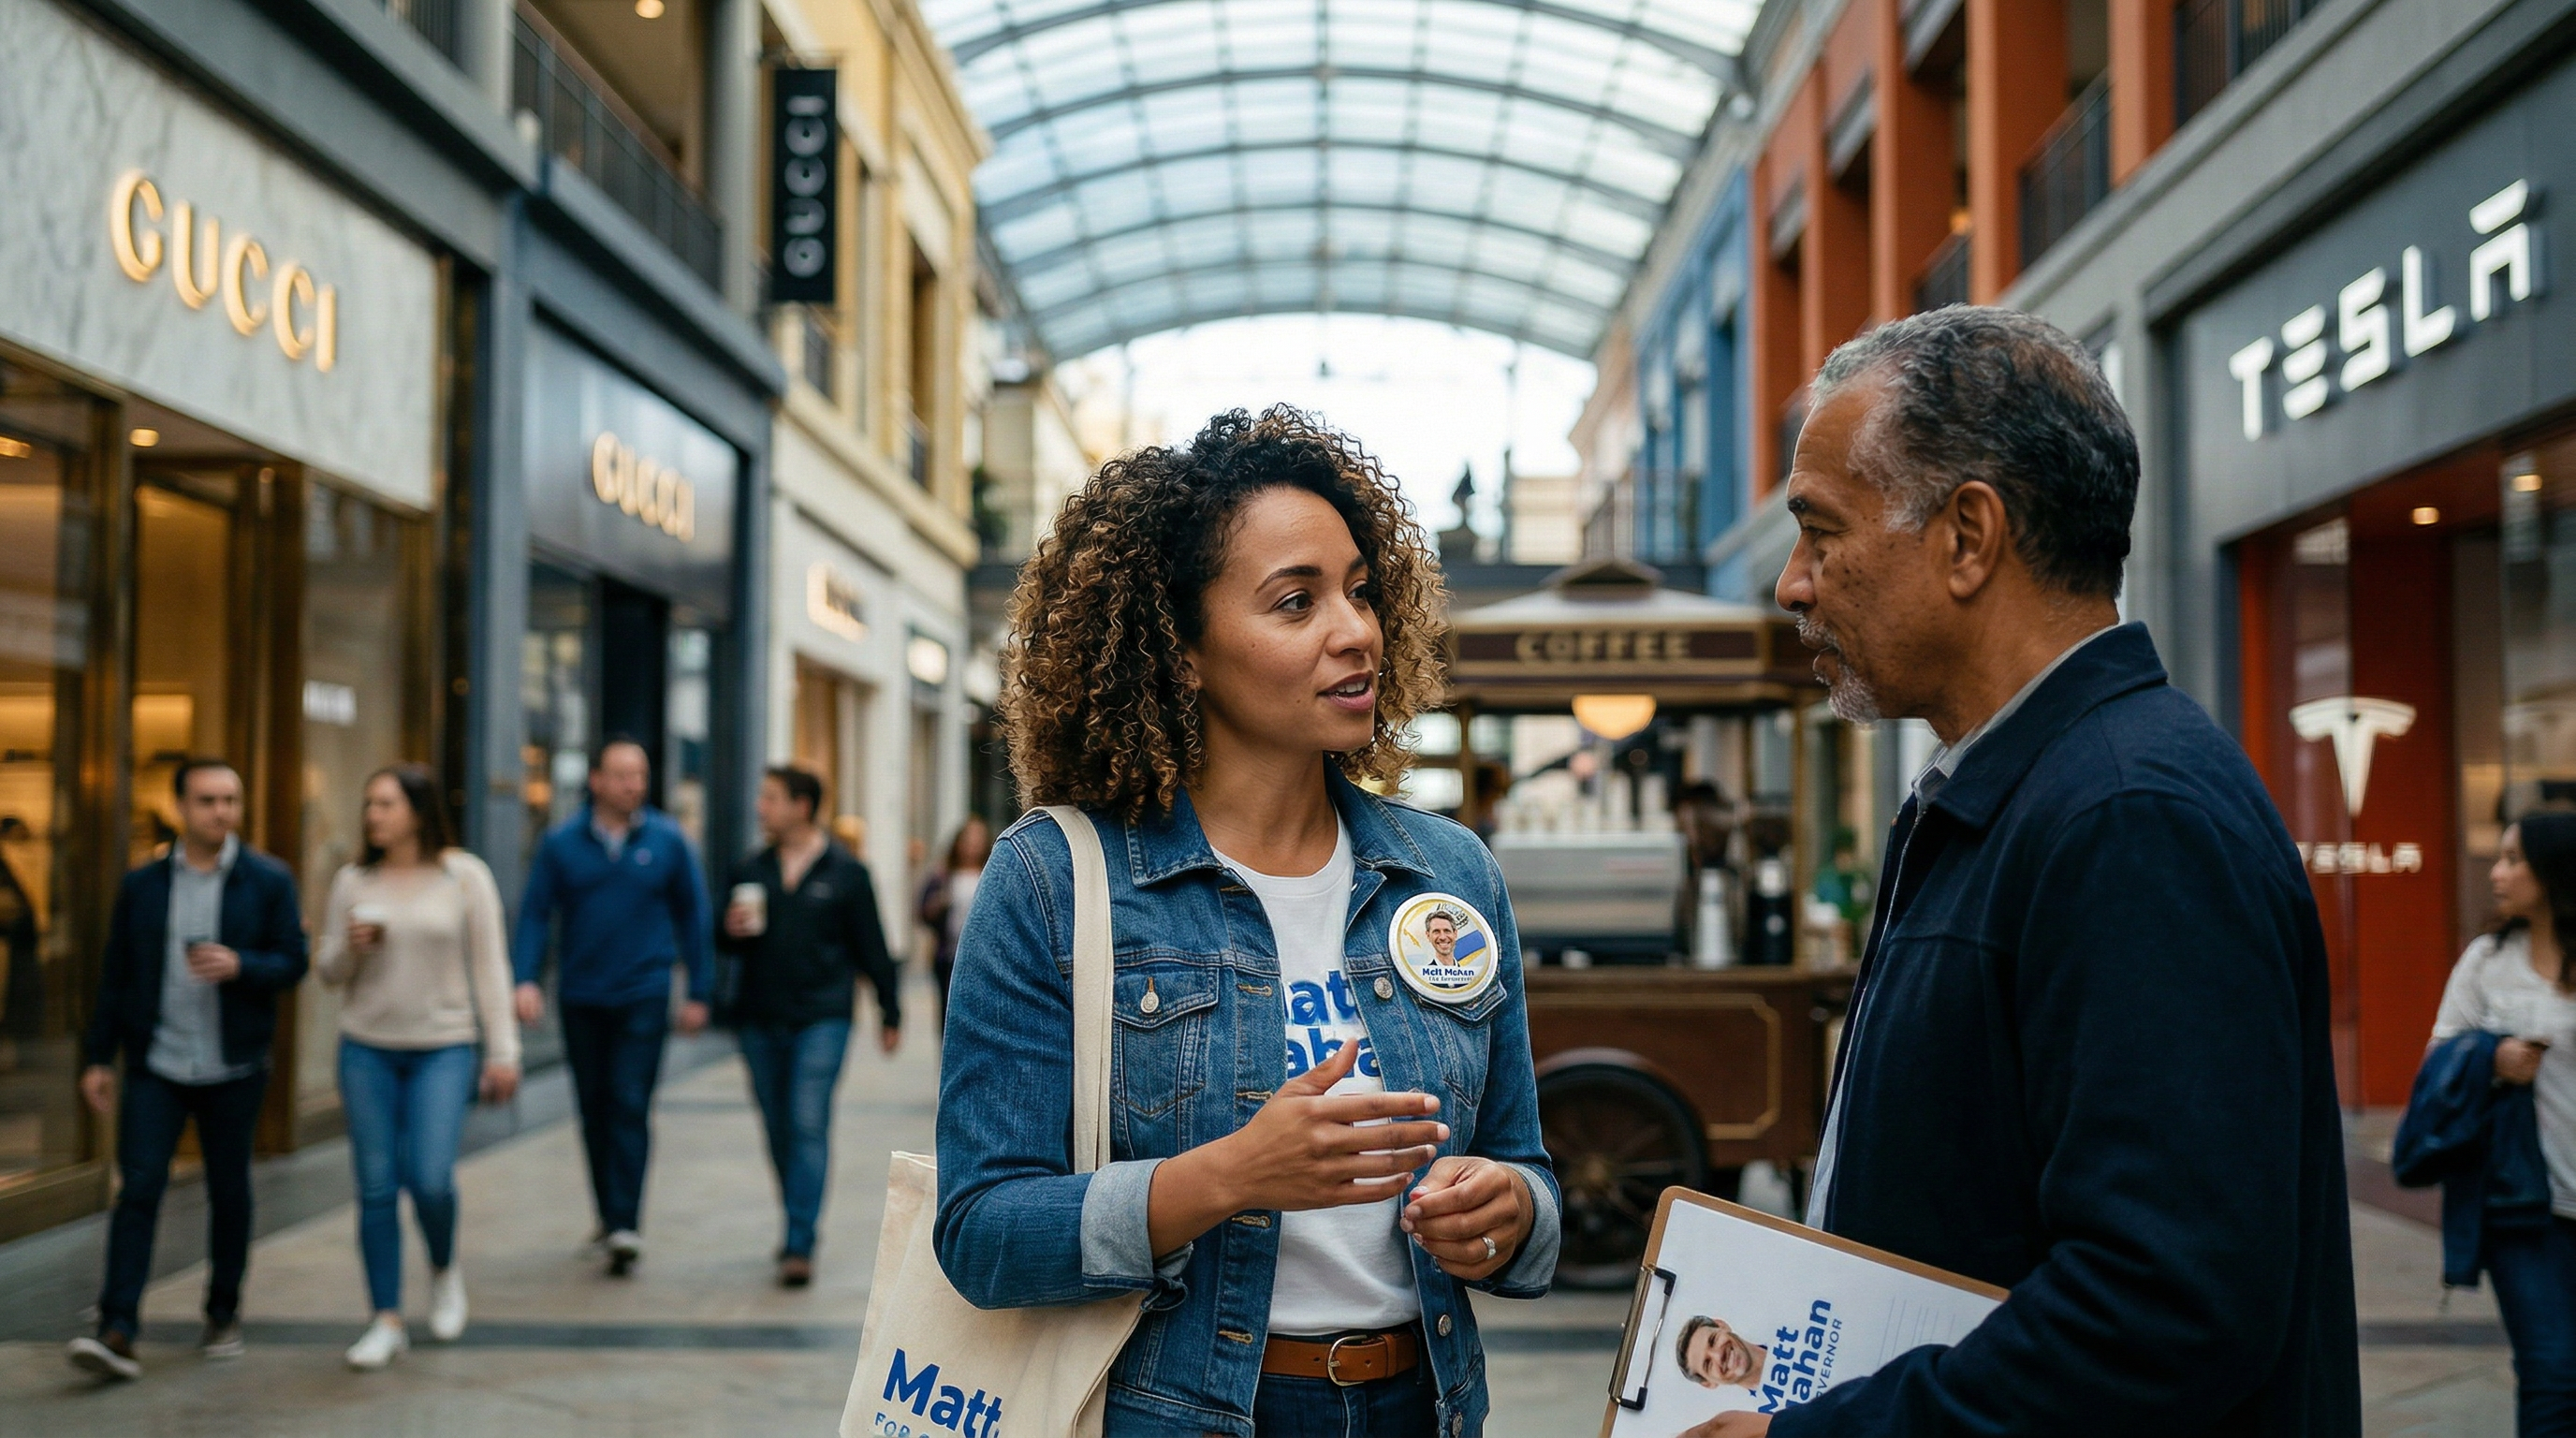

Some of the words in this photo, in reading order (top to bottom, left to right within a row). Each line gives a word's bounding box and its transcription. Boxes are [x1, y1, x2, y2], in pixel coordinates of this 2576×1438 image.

[783, 95, 828, 278] GUCCI
[110, 169, 336, 374] GUCCI
[2229, 178, 2530, 442] TESLA
[593, 431, 695, 543] GUCCI
[1515, 631, 1690, 663] COFFEE
[883, 1347, 1003, 1438] Matt
[1758, 1326, 1798, 1415] Matt
